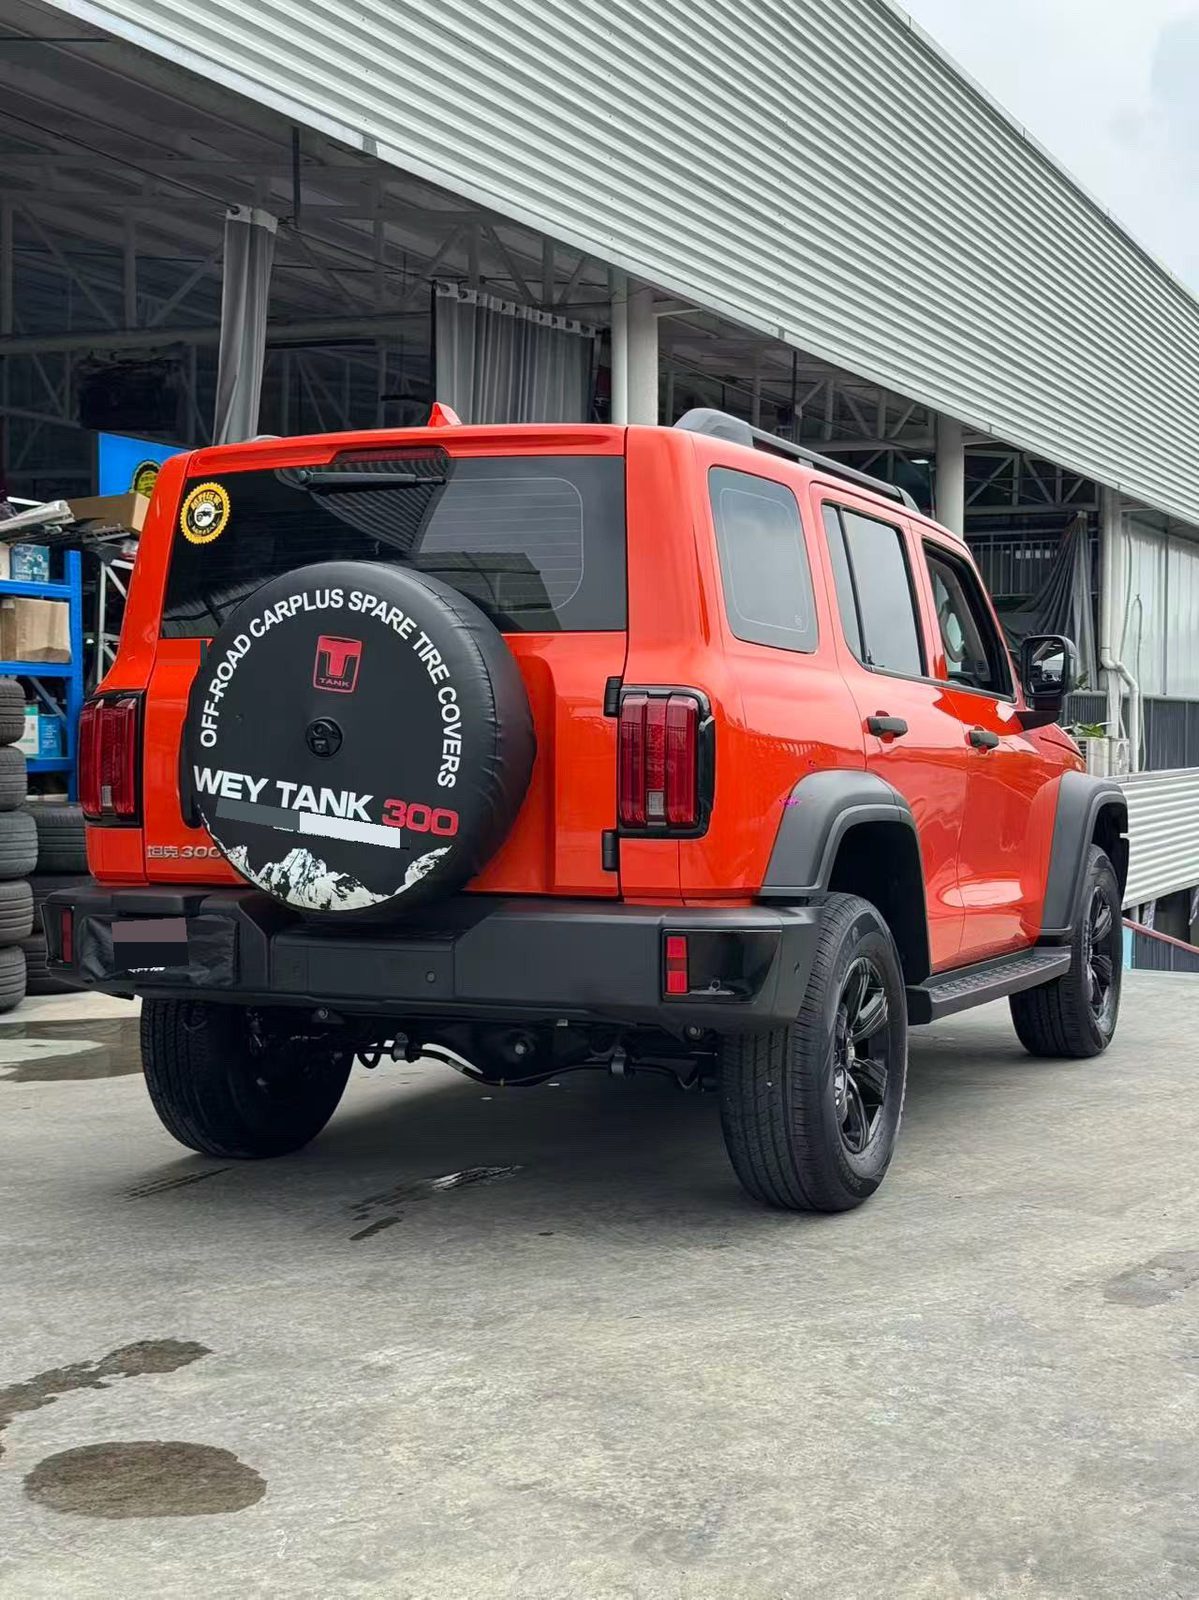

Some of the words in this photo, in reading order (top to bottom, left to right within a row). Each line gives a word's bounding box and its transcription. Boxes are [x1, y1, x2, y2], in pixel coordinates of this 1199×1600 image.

[199, 633, 251, 748] OFF-ROAD
[249, 588, 344, 638] CARPLUS
[347, 590, 418, 640] SPARE
[412, 630, 451, 685] TIRE
[437, 686, 462, 788] COVERS
[319, 677, 351, 688] TANK
[193, 765, 270, 803] WEY
[275, 780, 375, 822] TANK
[381, 798, 460, 837] 300
